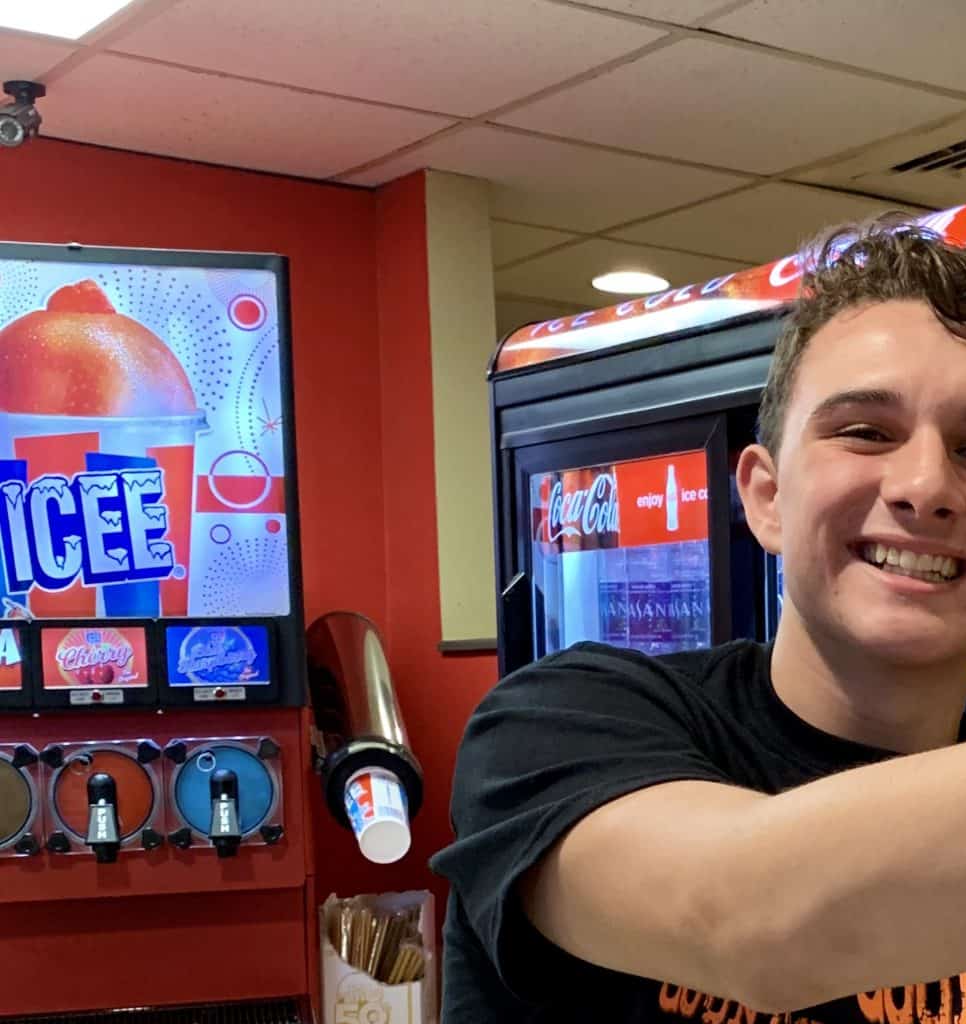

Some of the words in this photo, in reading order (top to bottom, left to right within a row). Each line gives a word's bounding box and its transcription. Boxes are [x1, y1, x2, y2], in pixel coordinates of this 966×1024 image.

[636, 492, 664, 510] enjoy
[681, 487, 697, 502] ice
[0, 467, 176, 595] ICEE
[57, 642, 134, 671] Cherry
